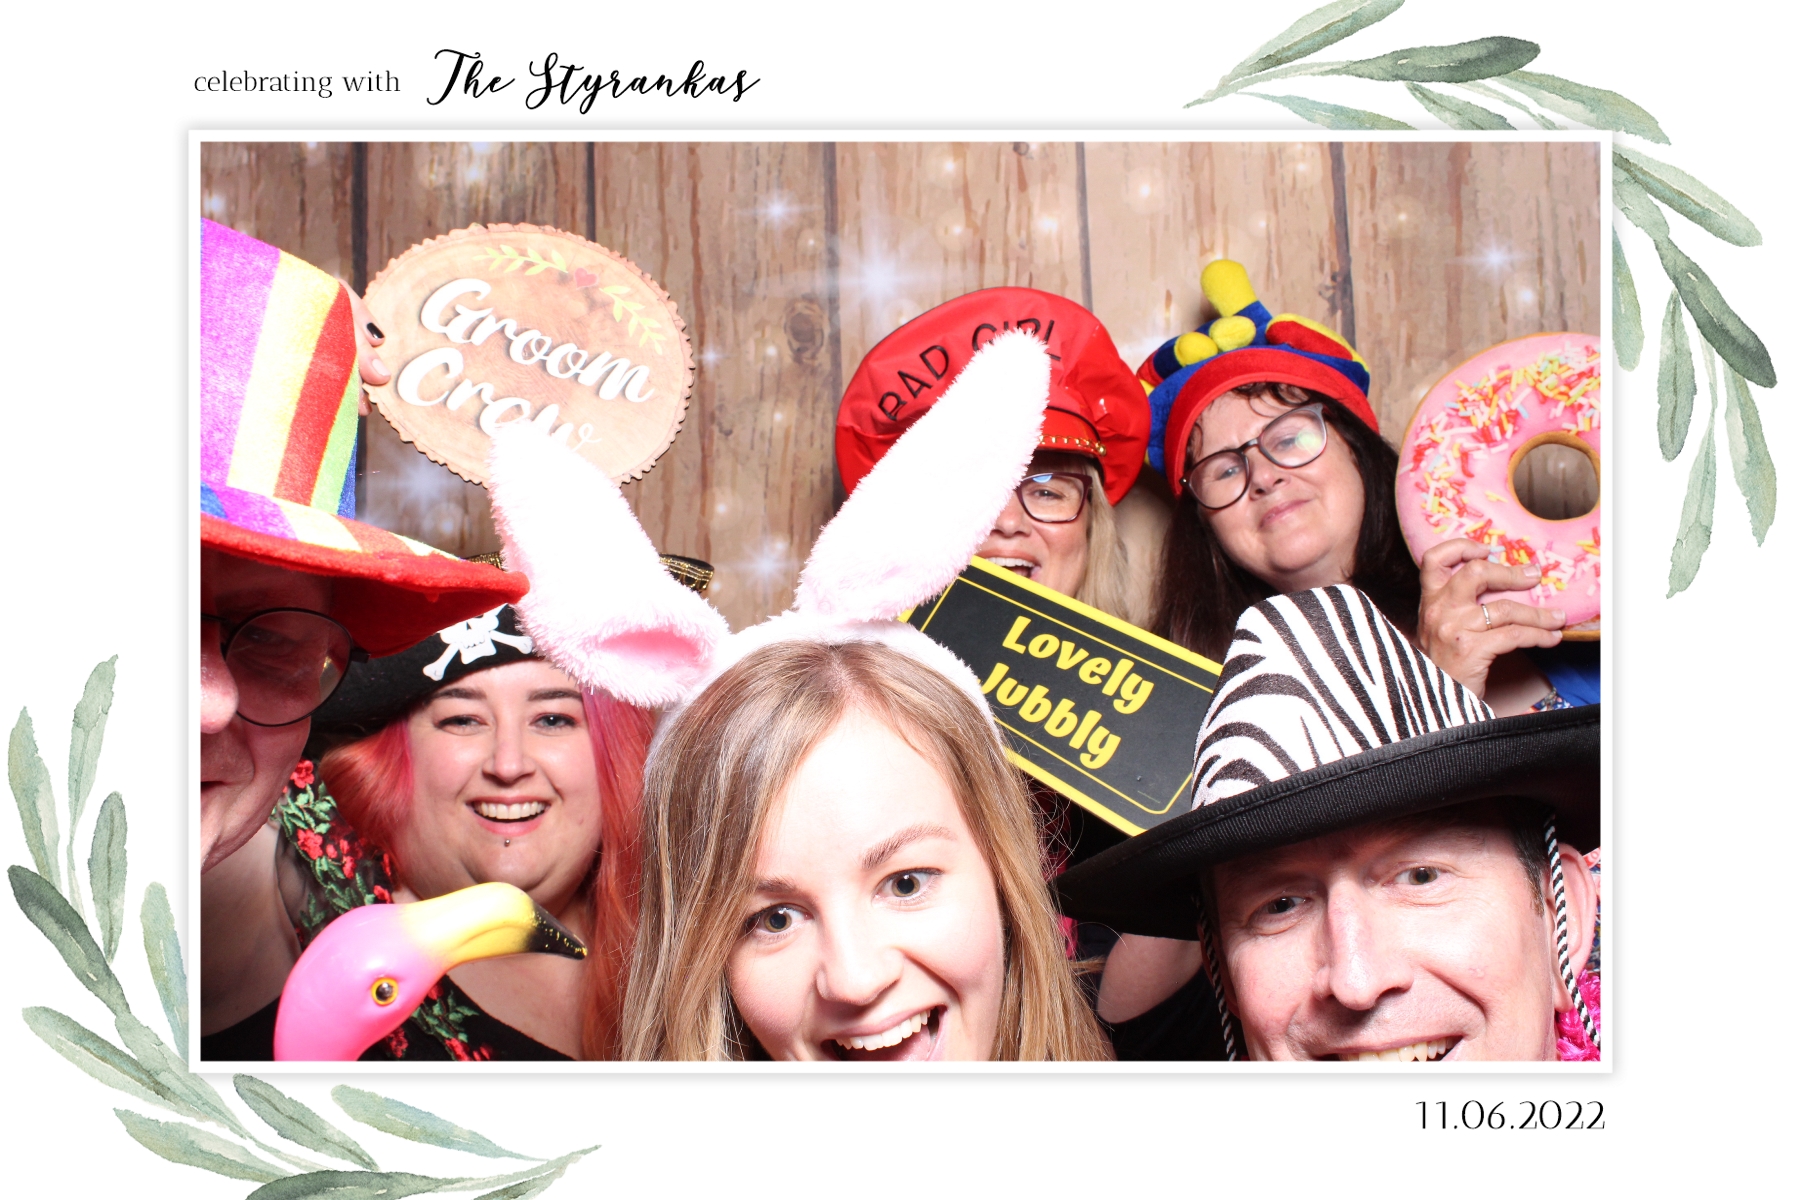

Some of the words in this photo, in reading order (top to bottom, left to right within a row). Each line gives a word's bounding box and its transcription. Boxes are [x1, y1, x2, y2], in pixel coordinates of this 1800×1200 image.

[420, 278, 656, 403] Groom
[878, 345, 949, 422] BAD
[971, 318, 1061, 362] GRL
[976, 662, 1122, 770] Jubbly
[1002, 615, 1155, 715] Lovely
